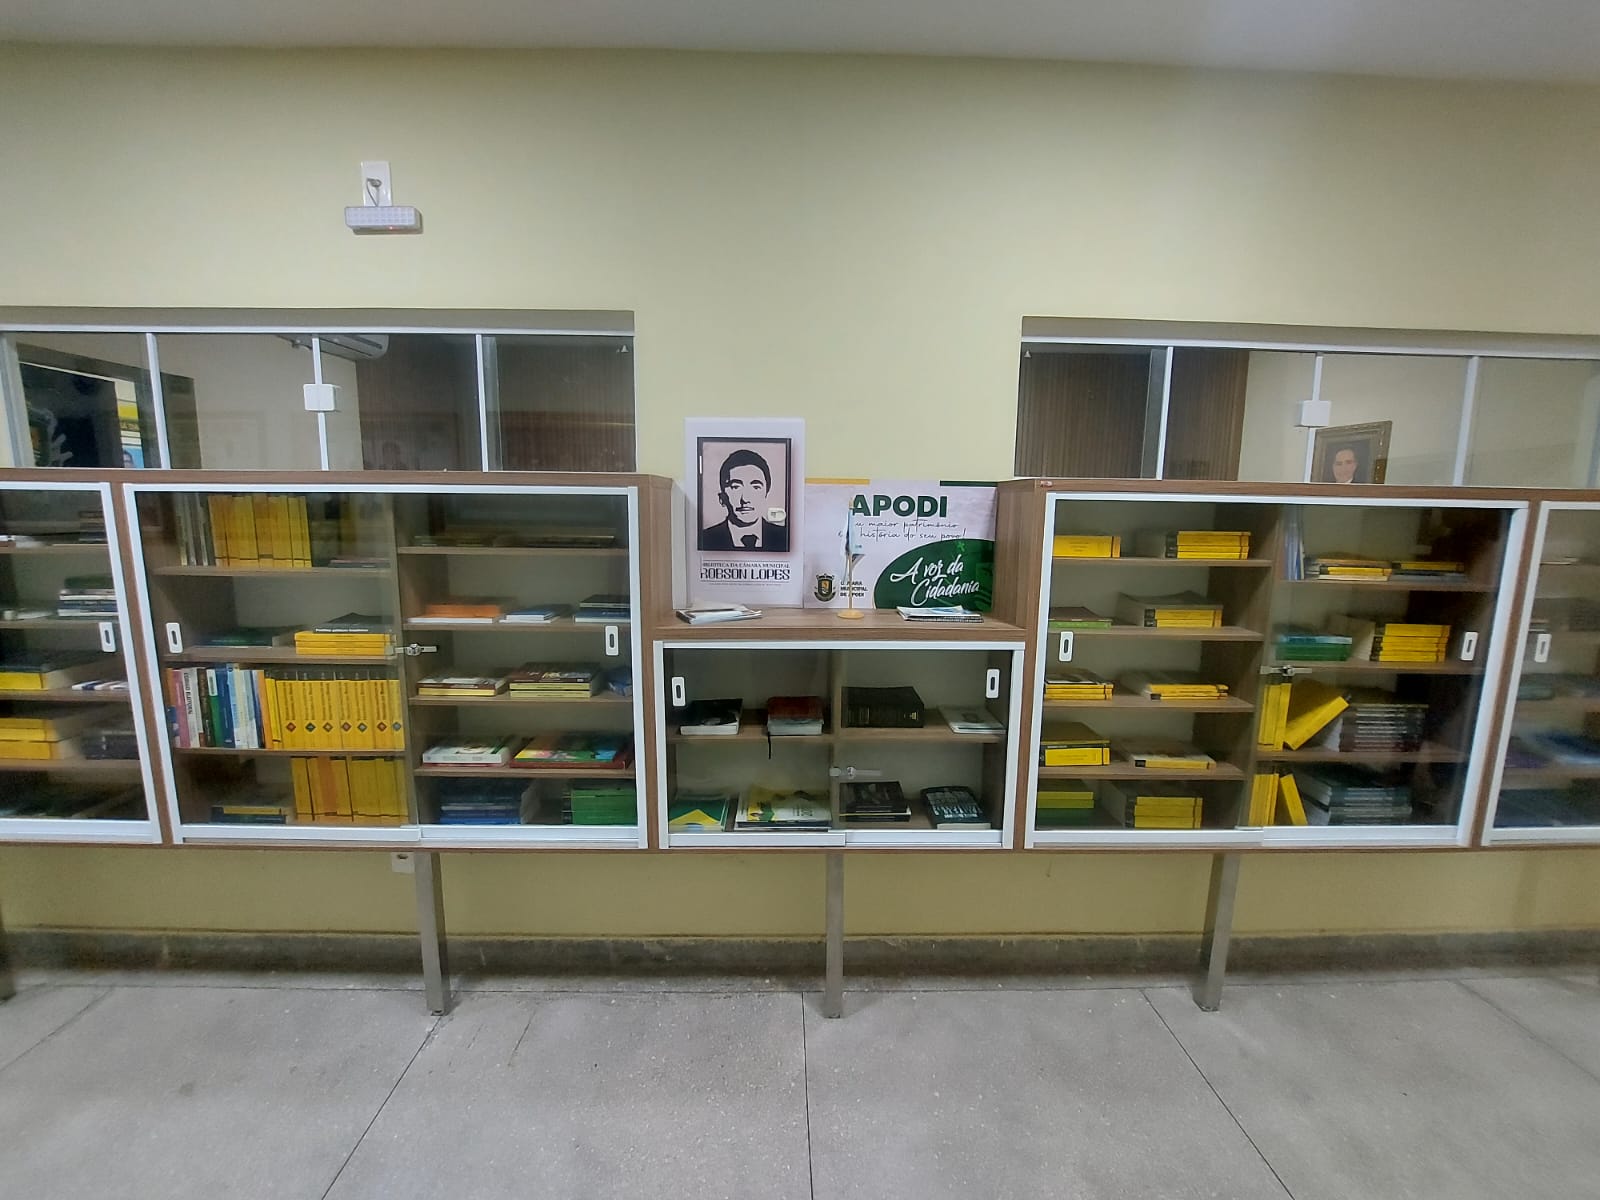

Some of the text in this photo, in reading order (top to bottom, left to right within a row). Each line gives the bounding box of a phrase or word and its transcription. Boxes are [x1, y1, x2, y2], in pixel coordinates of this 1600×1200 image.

[852, 494, 947, 518] APODI
[700, 567, 790, 581] ROBSON LOPES
[889, 554, 964, 585] A voz da
[910, 577, 980, 607] Cidadania
